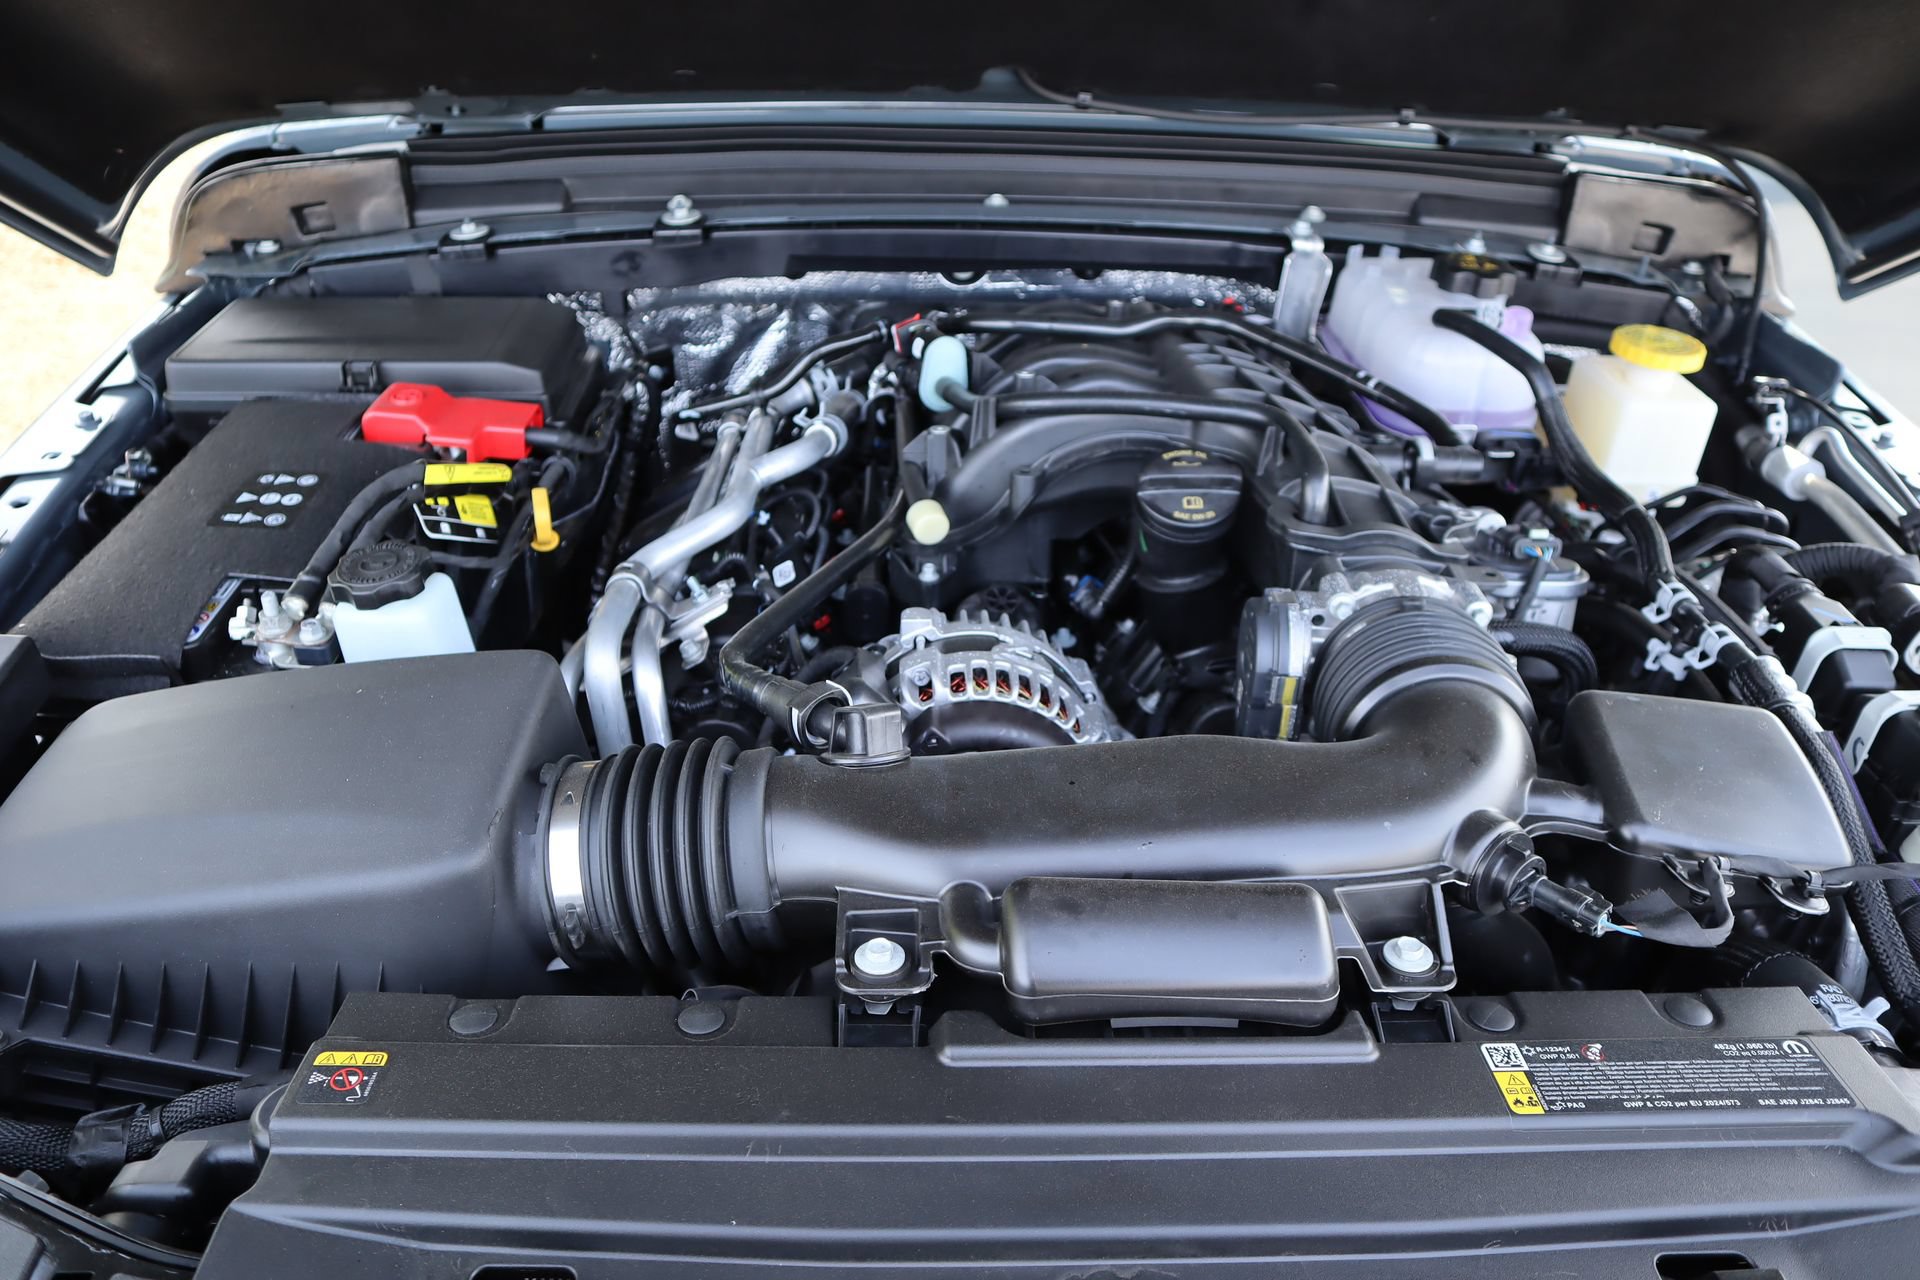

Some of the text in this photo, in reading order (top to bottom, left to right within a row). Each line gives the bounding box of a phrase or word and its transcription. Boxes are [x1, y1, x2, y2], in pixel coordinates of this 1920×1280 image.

[1162, 449, 1193, 459] ENGINE
[1819, 983, 1844, 994] RAD
[1714, 1043, 1736, 1051] 482g
[1763, 1042, 1778, 1050] lb)
[1567, 1101, 1586, 1109] PAG
[1654, 1100, 1674, 1108] CO2
[1674, 1101, 1689, 1109] per
[1703, 1099, 1741, 1107] 2024/573
